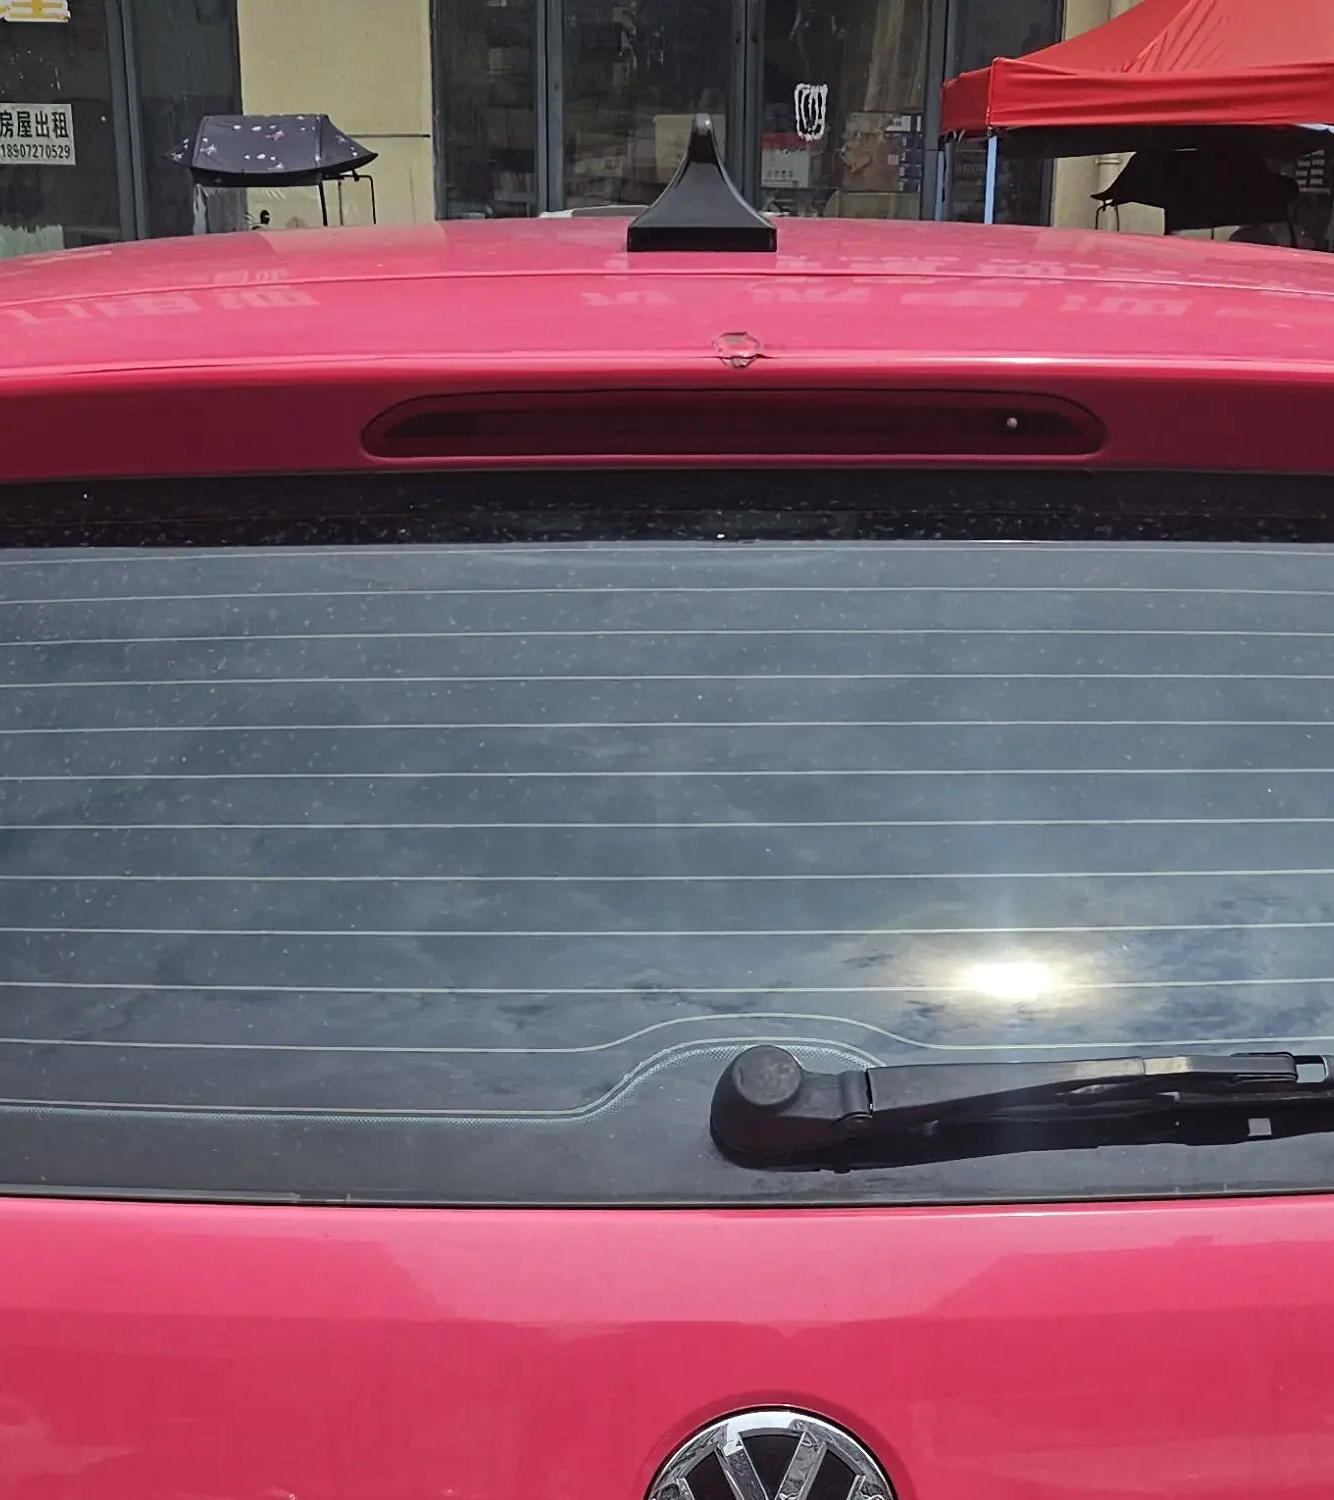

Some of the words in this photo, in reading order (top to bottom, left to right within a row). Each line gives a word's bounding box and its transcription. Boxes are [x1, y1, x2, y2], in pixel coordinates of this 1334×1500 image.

[0, 110, 69, 138] 房屋出租
[0, 144, 71, 159] 18907270529
